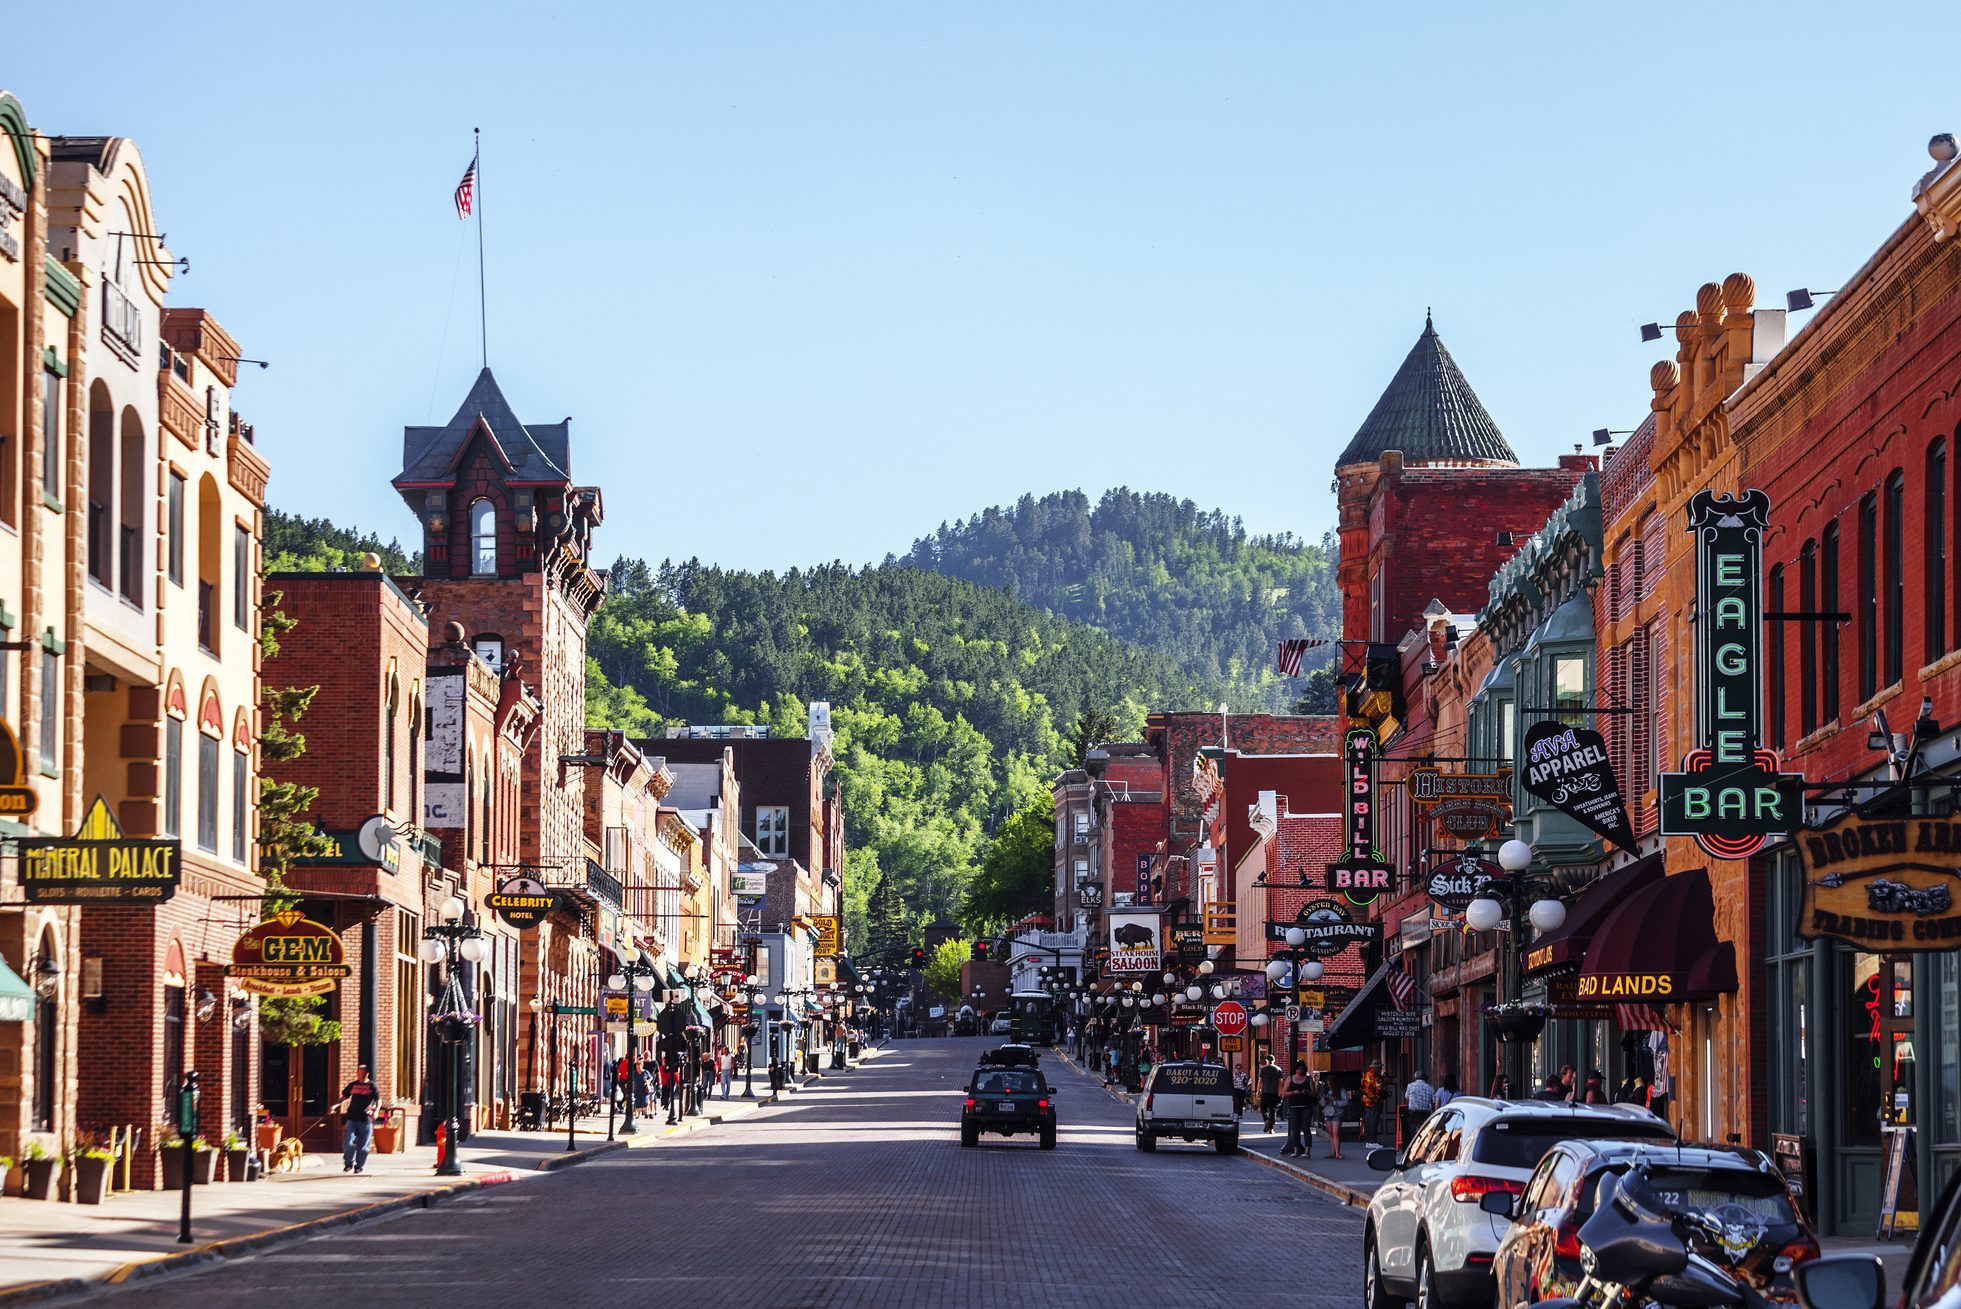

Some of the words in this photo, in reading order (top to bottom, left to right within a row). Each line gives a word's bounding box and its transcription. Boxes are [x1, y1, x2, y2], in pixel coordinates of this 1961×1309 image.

[1716, 553, 1747, 763] EAGLE
[1530, 729, 1580, 763] AVA
[1353, 737, 1369, 794] WILD
[1529, 744, 1607, 786] APPAREL
[1603, 791, 1618, 801] JEANS
[1684, 787, 1784, 821] BAR
[1594, 806, 1621, 821] AMERICA'S
[1602, 815, 1618, 825] BIKER
[1447, 815, 1489, 830] CLUB
[1353, 802, 1369, 859] BILL
[1806, 822, 1907, 869] BROKEN
[26, 847, 101, 880] MINERAL
[109, 846, 174, 879] PALACE
[1335, 869, 1390, 888] BAR
[1428, 873, 1472, 896] Sick
[131, 886, 163, 897] CARDS
[491, 895, 554, 908] CELEBRITY
[1081, 896, 1102, 904] ELKS
[1303, 901, 1332, 917] OYSTER
[813, 918, 832, 927] GOLD
[1813, 909, 1903, 941] TRADING
[1274, 925, 1375, 938] RTAURANT
[262, 935, 332, 963] GEM
[1310, 944, 1340, 954] GAMING
[229, 965, 291, 977] Steakhouse
[295, 965, 307, 977] &
[309, 965, 346, 977] Saloon
[1112, 957, 1160, 970] SALOON
[1578, 975, 1598, 996] BAD
[1601, 974, 1673, 995] LANDS
[1215, 1012, 1245, 1025] STOP
[1201, 1069, 1220, 1077] TAXI
